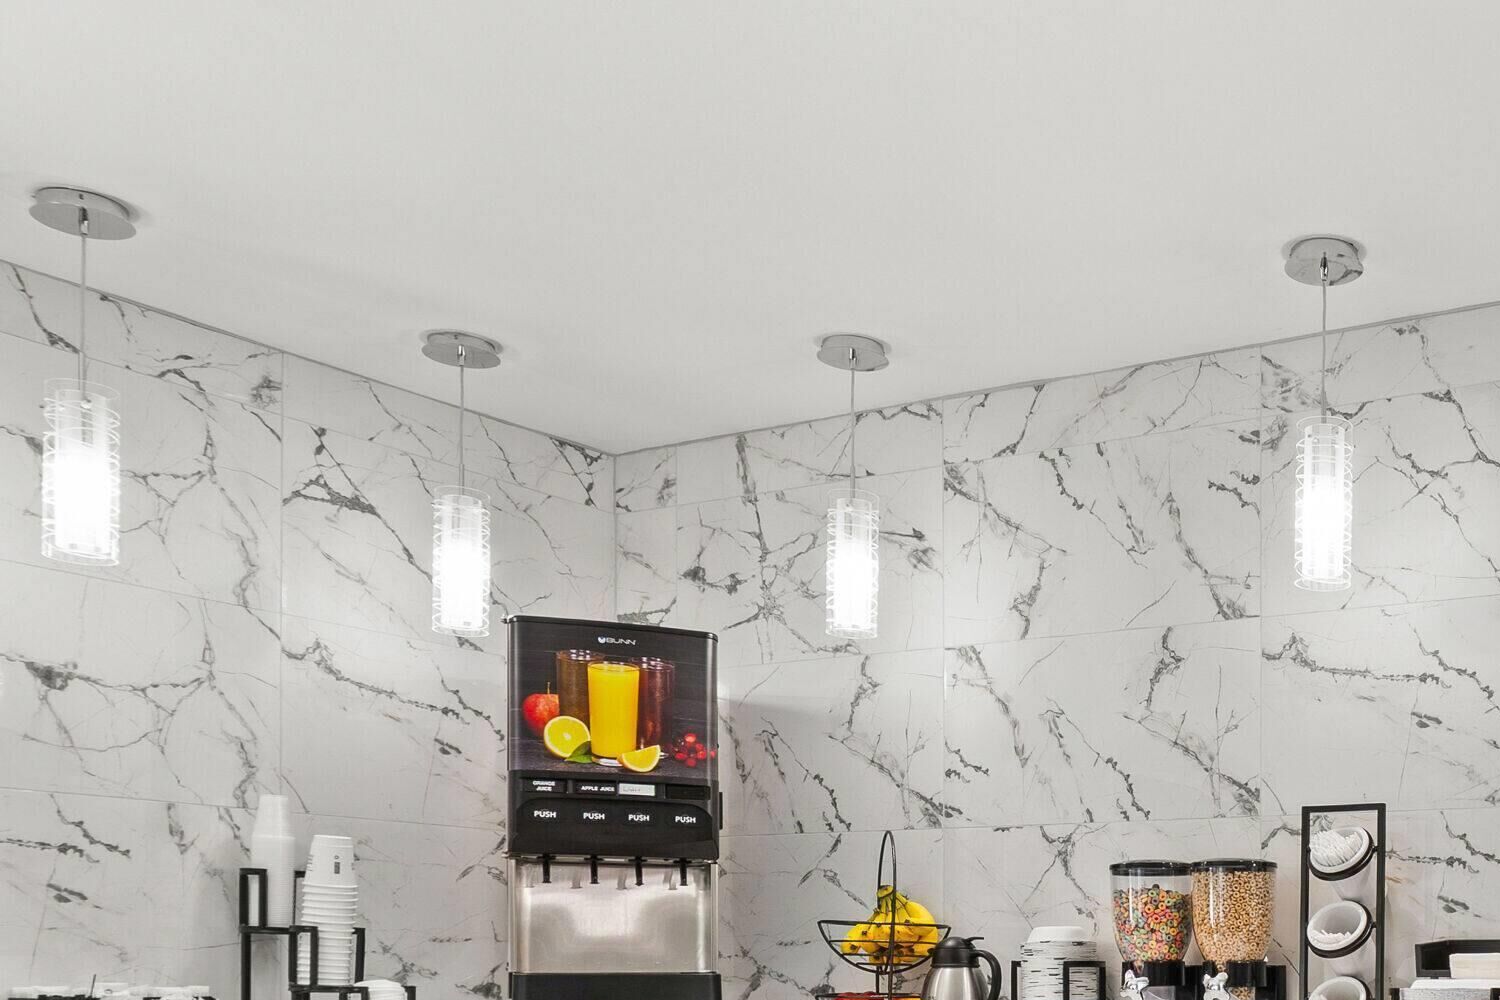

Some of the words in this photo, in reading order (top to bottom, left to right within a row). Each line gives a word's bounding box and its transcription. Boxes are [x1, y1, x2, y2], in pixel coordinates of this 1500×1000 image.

[606, 637, 636, 645] BUNN
[534, 810, 557, 818] PUSH
[583, 812, 605, 820] PUSH
[628, 814, 650, 822] PUSH
[675, 815, 697, 824] PUSH
